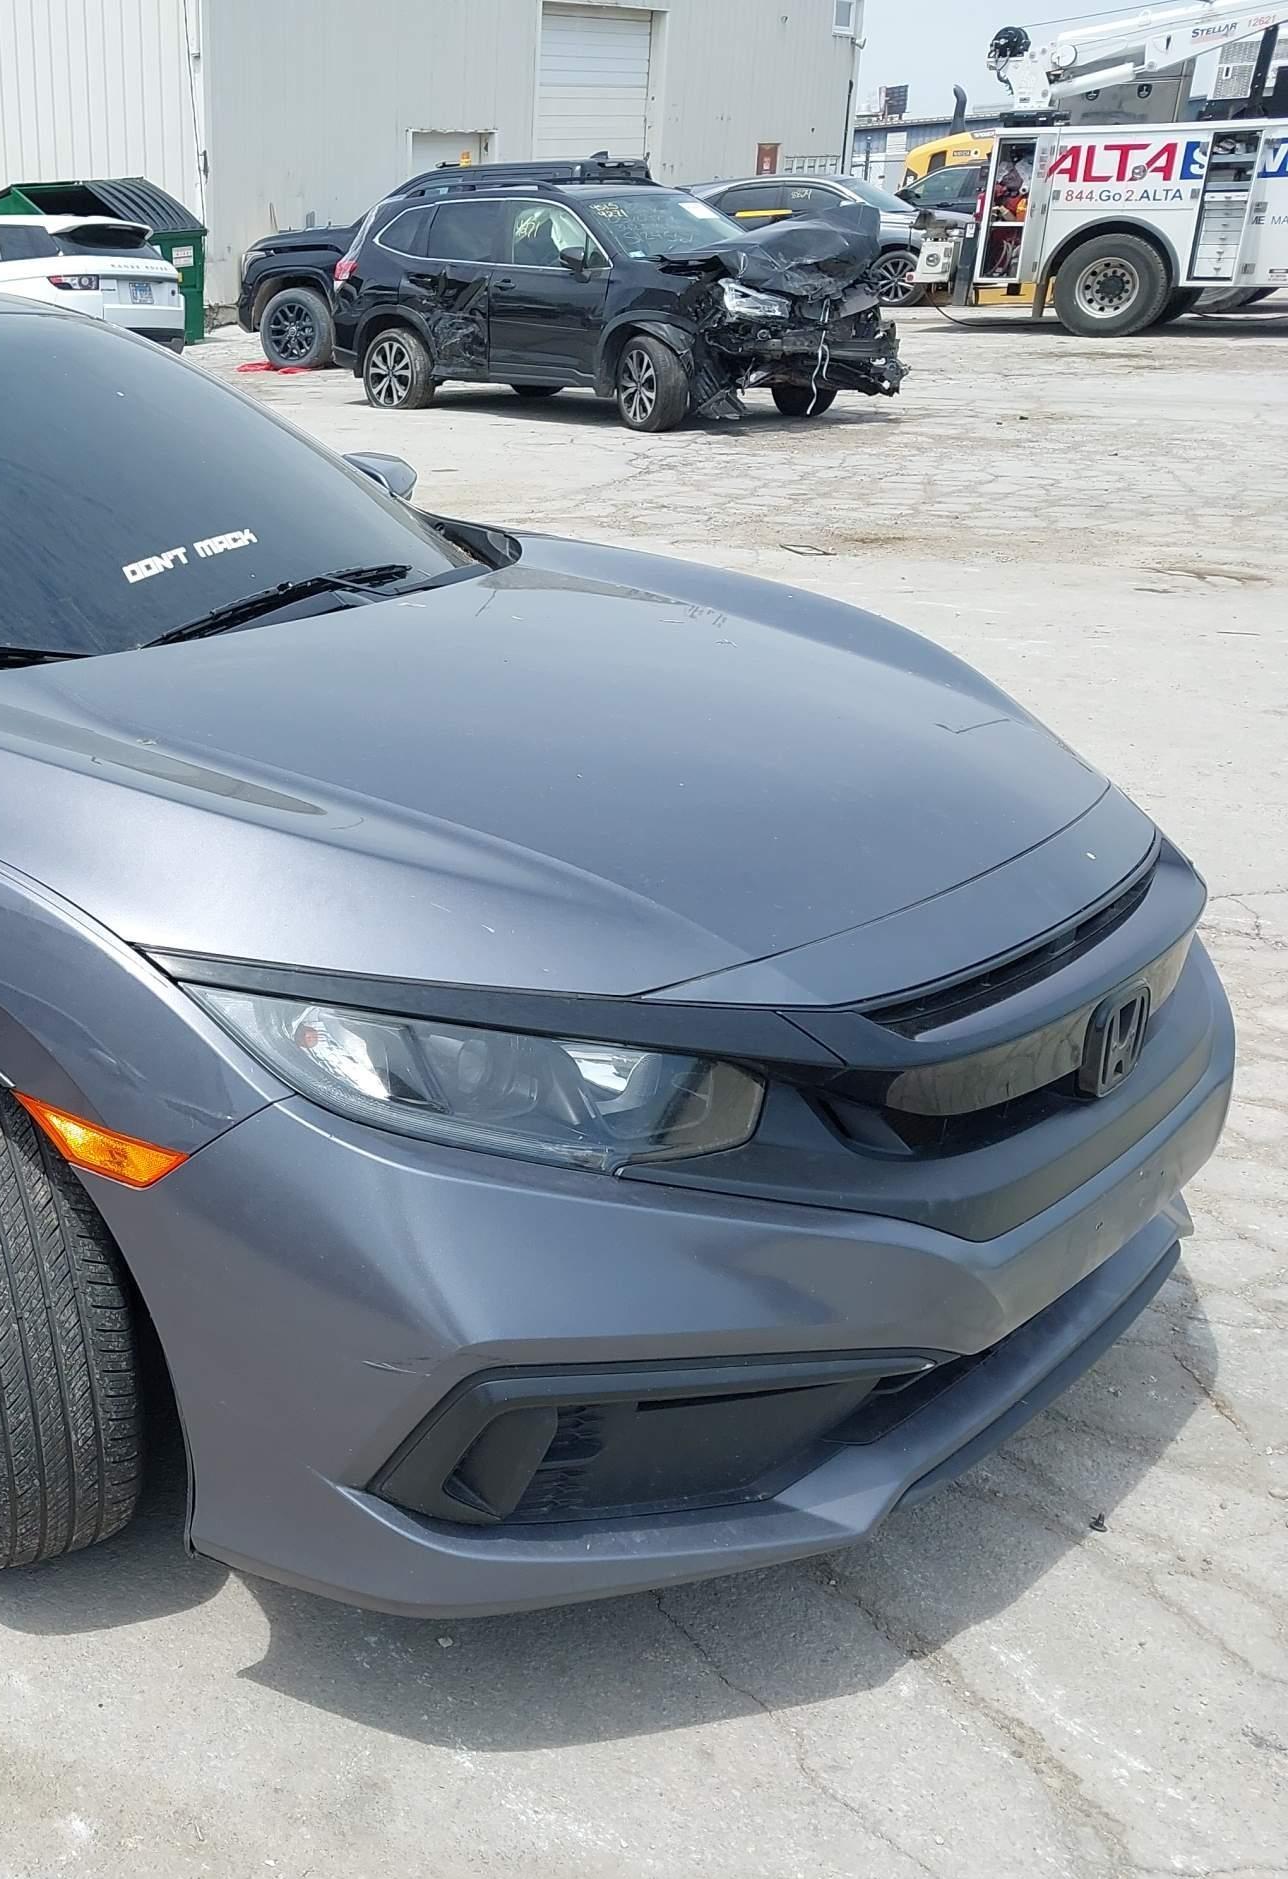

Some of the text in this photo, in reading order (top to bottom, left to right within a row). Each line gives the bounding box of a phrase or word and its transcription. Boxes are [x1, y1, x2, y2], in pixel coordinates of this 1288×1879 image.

[1192, 23, 1238, 38] STELLAR
[1046, 143, 1178, 182] ALTA
[192, 528, 258, 558] MACK
